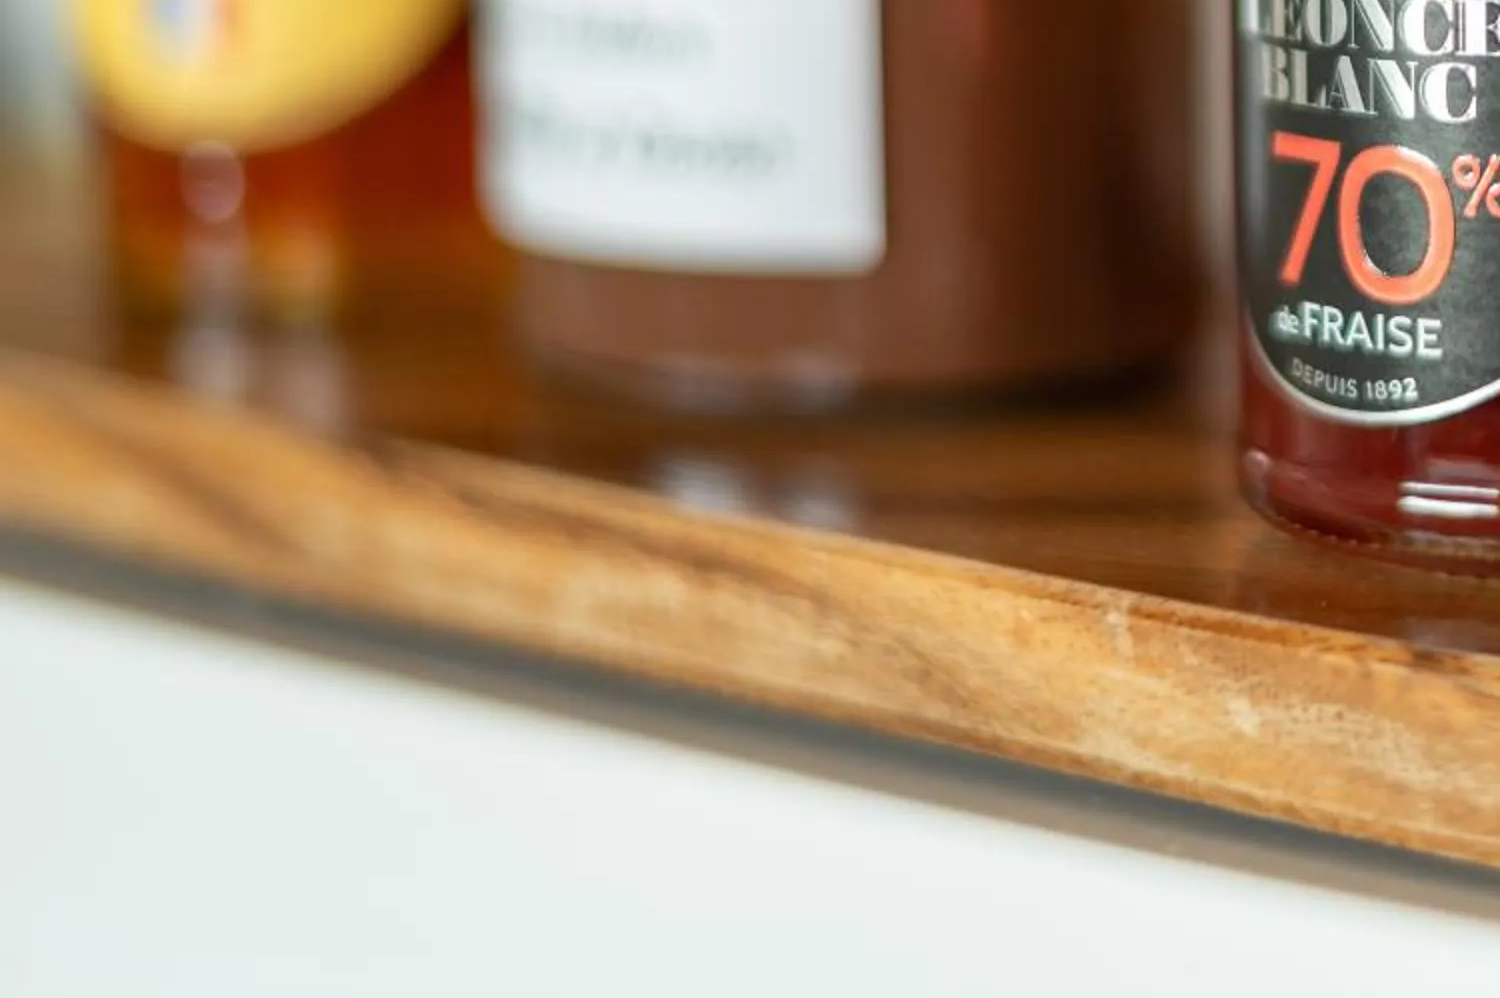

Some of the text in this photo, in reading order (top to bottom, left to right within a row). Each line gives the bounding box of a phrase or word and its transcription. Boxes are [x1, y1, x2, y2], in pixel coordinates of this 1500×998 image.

[1261, 43, 1478, 124] BLANC
[1301, 301, 1443, 358] FRAISE
[1291, 357, 1418, 401] DEPUIS 1892
